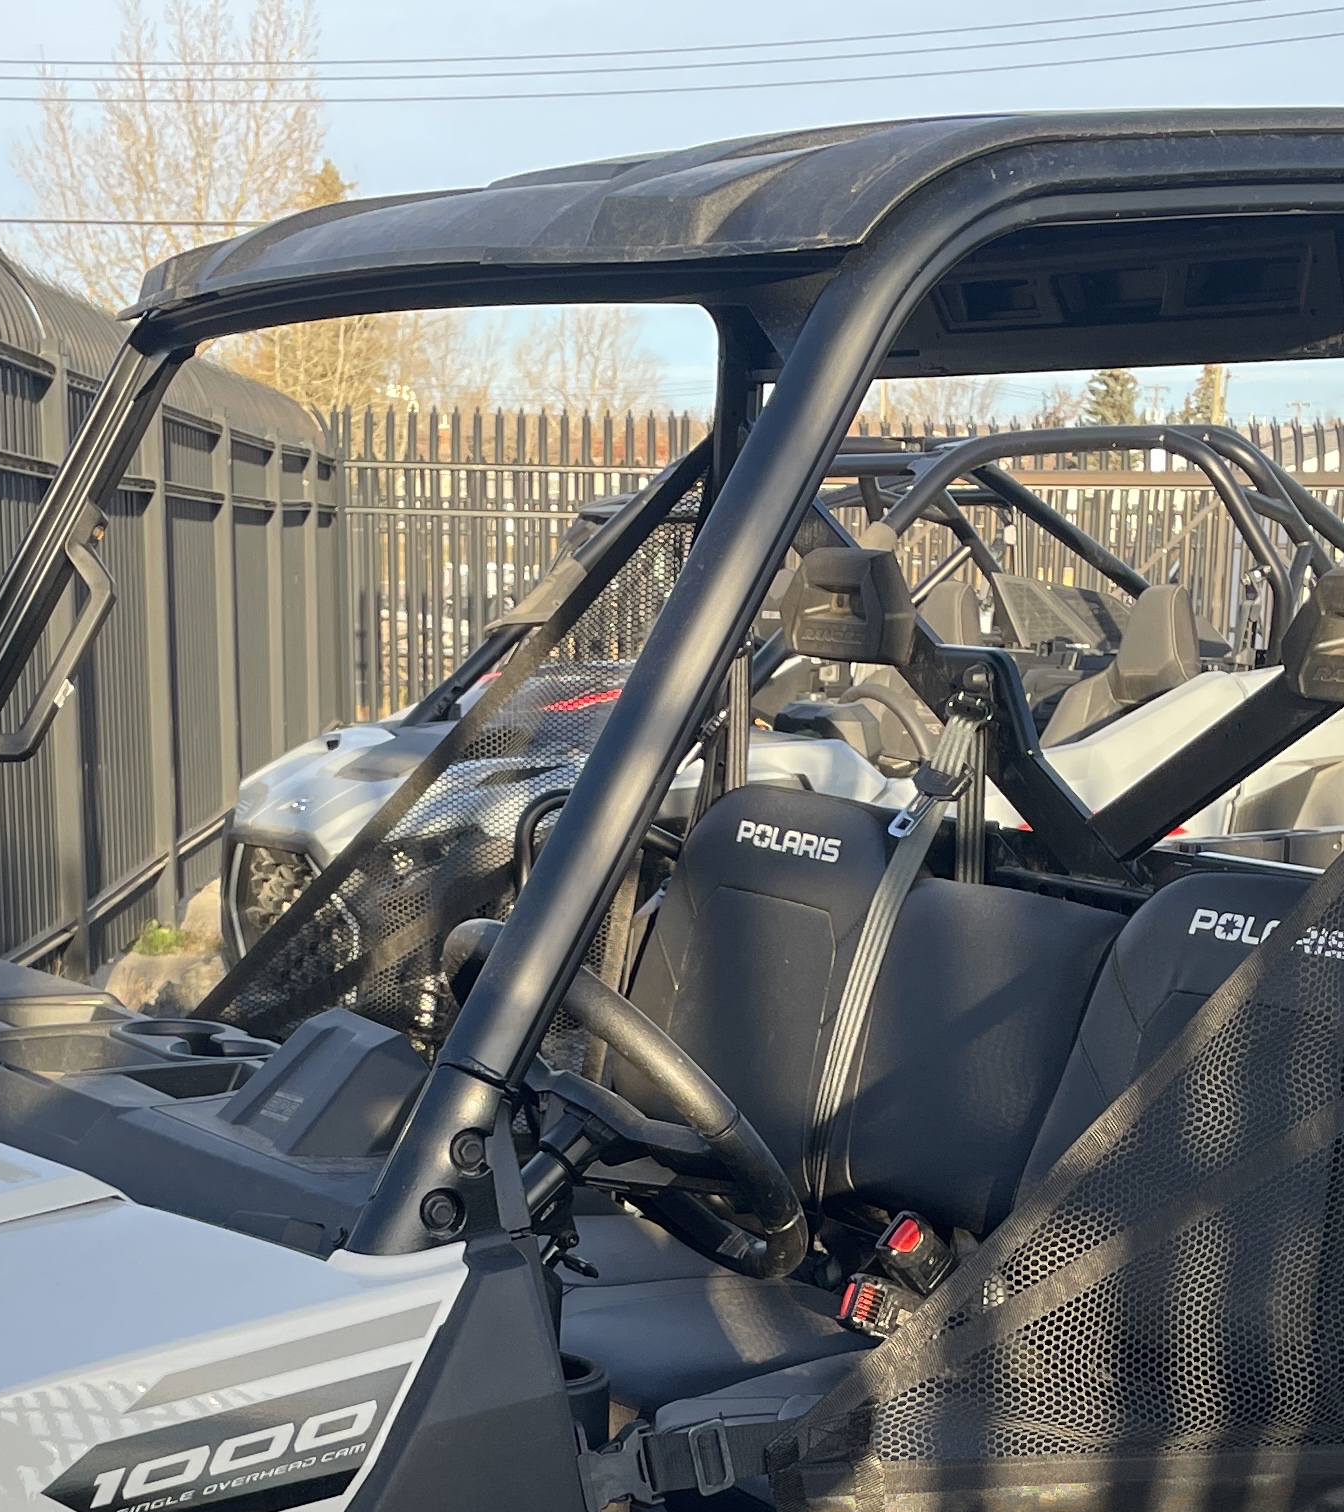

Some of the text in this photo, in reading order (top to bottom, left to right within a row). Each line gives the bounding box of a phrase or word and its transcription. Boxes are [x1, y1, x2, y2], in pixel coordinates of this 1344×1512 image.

[736, 819, 842, 863] POLARIS
[89, 1399, 378, 1510] 1000
[202, 1457, 316, 1496] OVERHEAD
[320, 1442, 367, 1463] CAM
